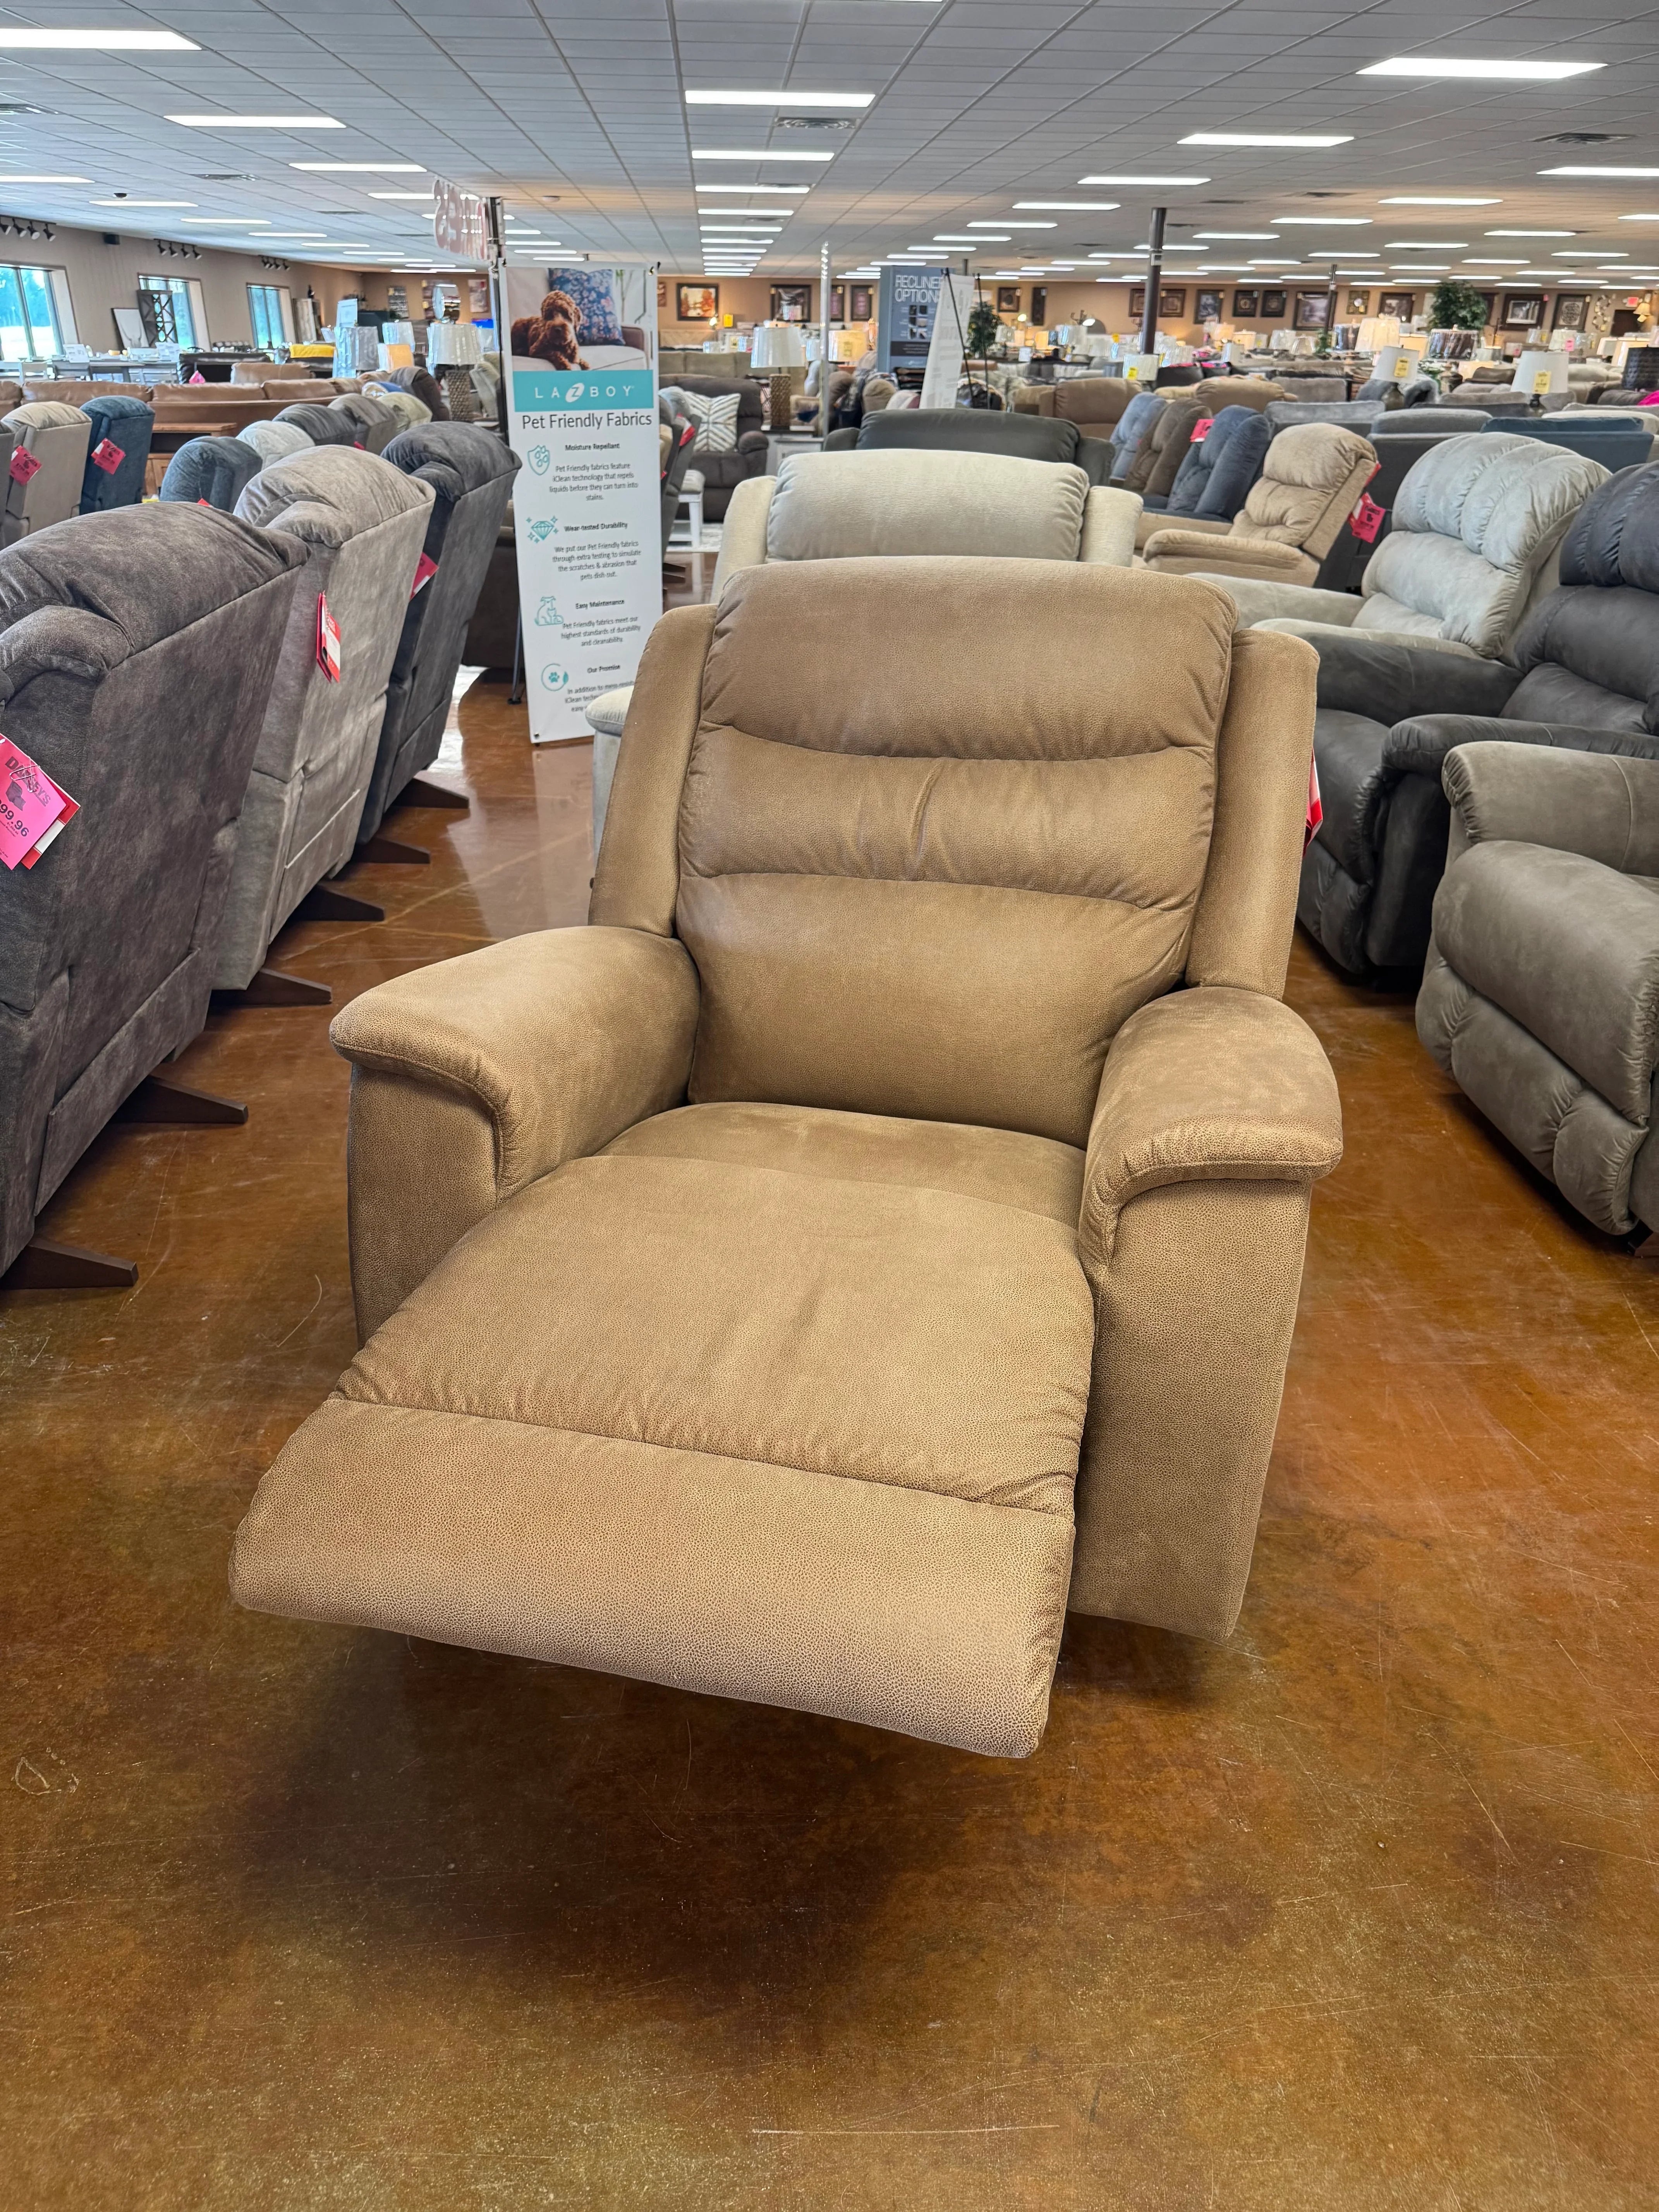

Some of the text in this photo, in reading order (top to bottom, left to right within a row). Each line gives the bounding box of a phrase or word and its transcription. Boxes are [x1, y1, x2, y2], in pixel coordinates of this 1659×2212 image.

[895, 288, 939, 303] OPTION
[522, 412, 652, 430] Pet Friendly Fabrics
[561, 632, 582, 640] highest
[616, 625, 641, 633] durability
[574, 686, 597, 694] addition
[0, 799, 29, 837] 99.96
